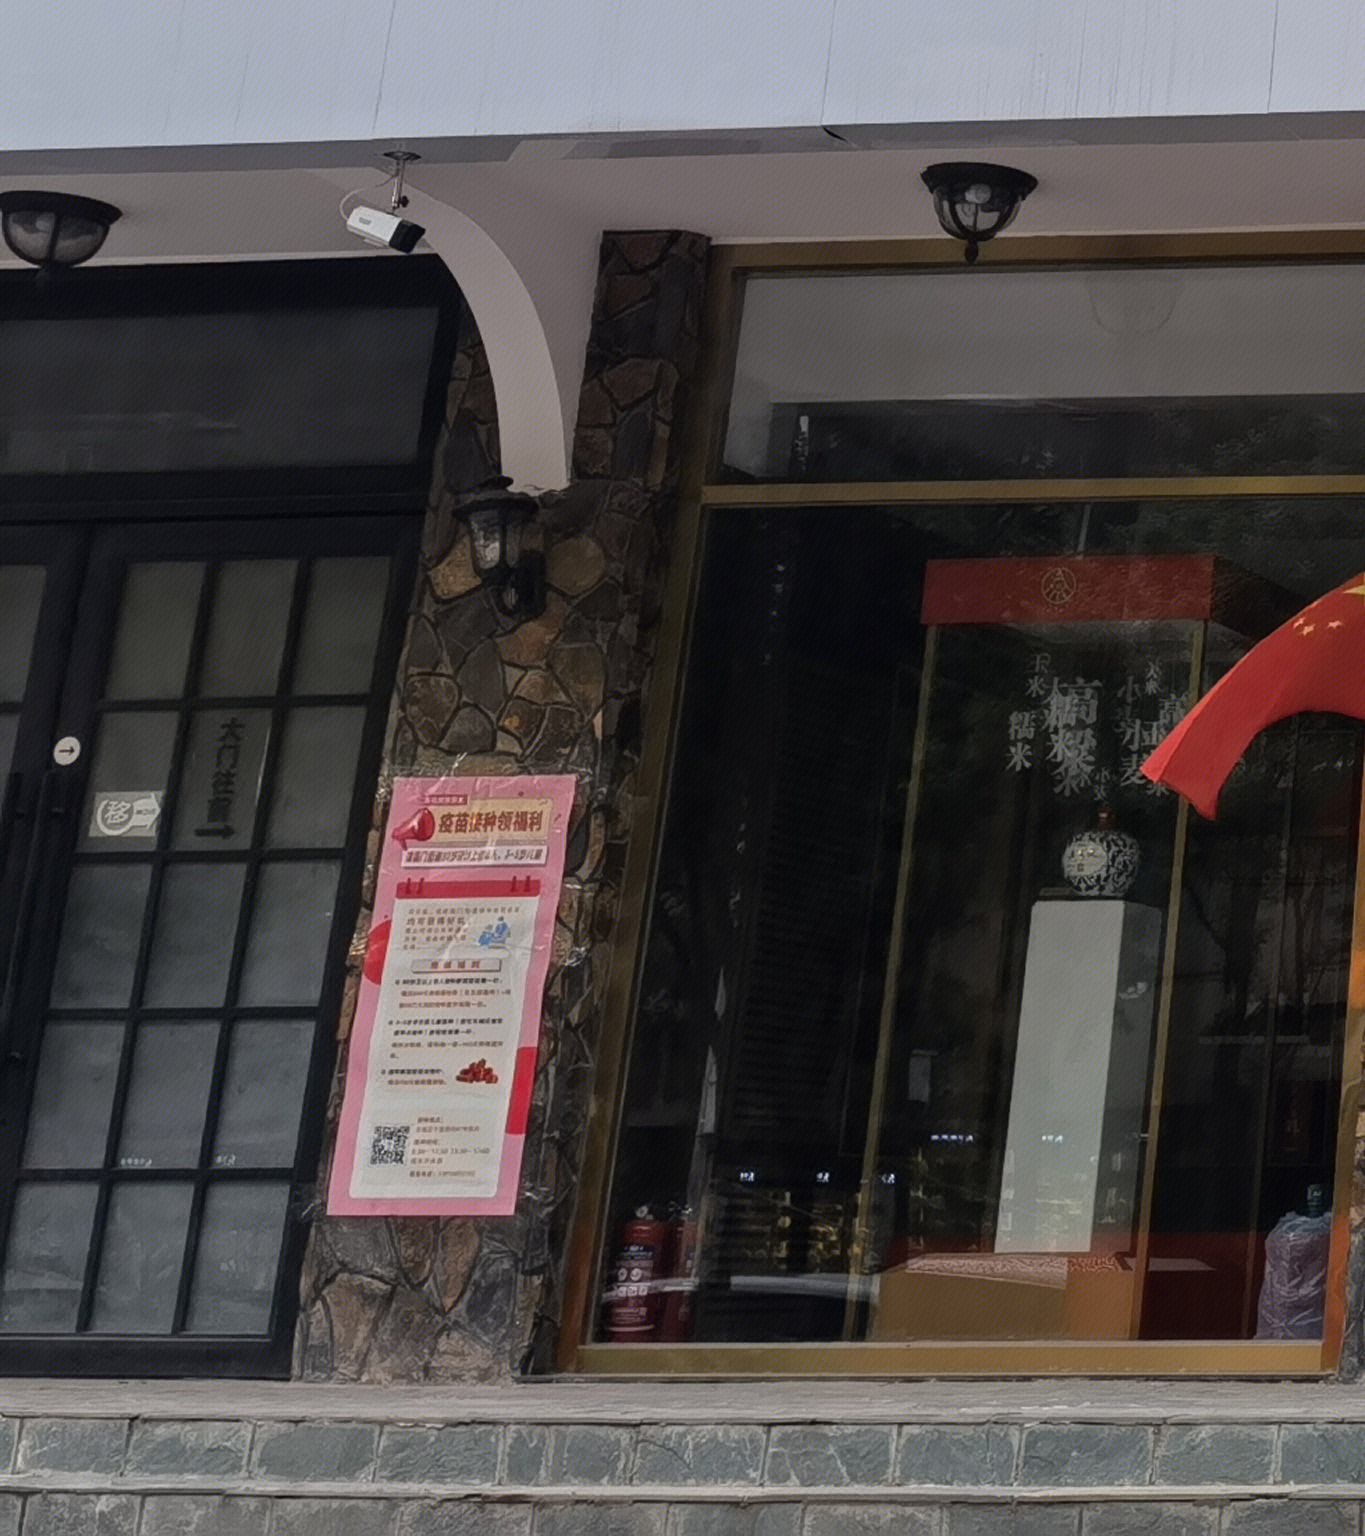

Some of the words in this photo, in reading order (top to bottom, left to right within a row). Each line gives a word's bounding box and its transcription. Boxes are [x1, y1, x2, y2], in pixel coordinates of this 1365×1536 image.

[438, 809, 544, 834] 疫苗接种领福利
